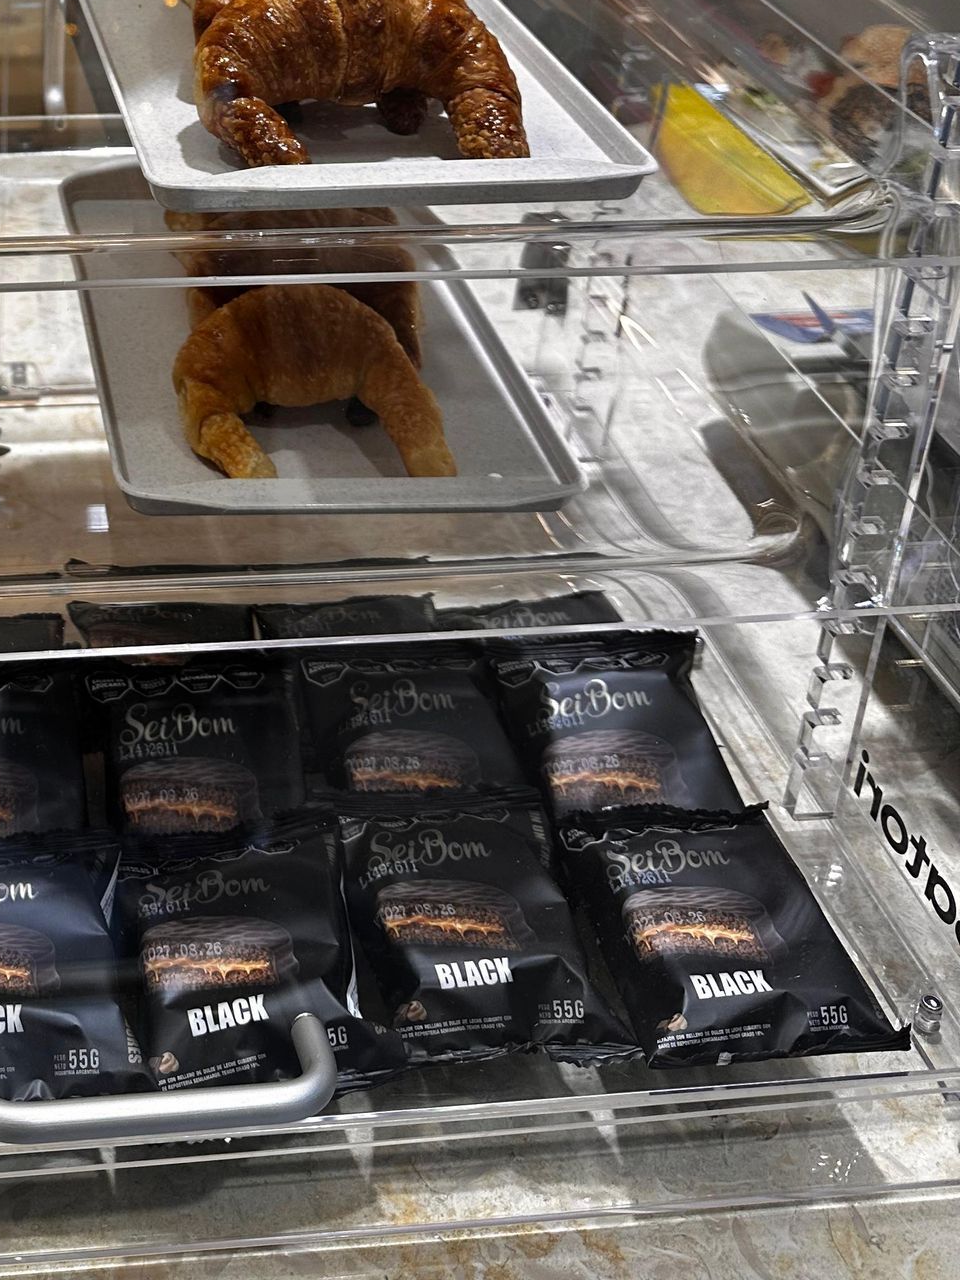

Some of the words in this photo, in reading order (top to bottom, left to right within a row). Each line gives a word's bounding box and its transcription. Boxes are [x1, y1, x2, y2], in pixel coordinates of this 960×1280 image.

[434, 957, 514, 990] BLACK
[689, 969, 774, 1000] BLACK
[186, 993, 270, 1038] BLACK
[553, 999, 584, 1019] 55G
[820, 1005, 848, 1025] 55G
[327, 1026, 348, 1047] 5G
[68, 1048, 99, 1069] 55G
